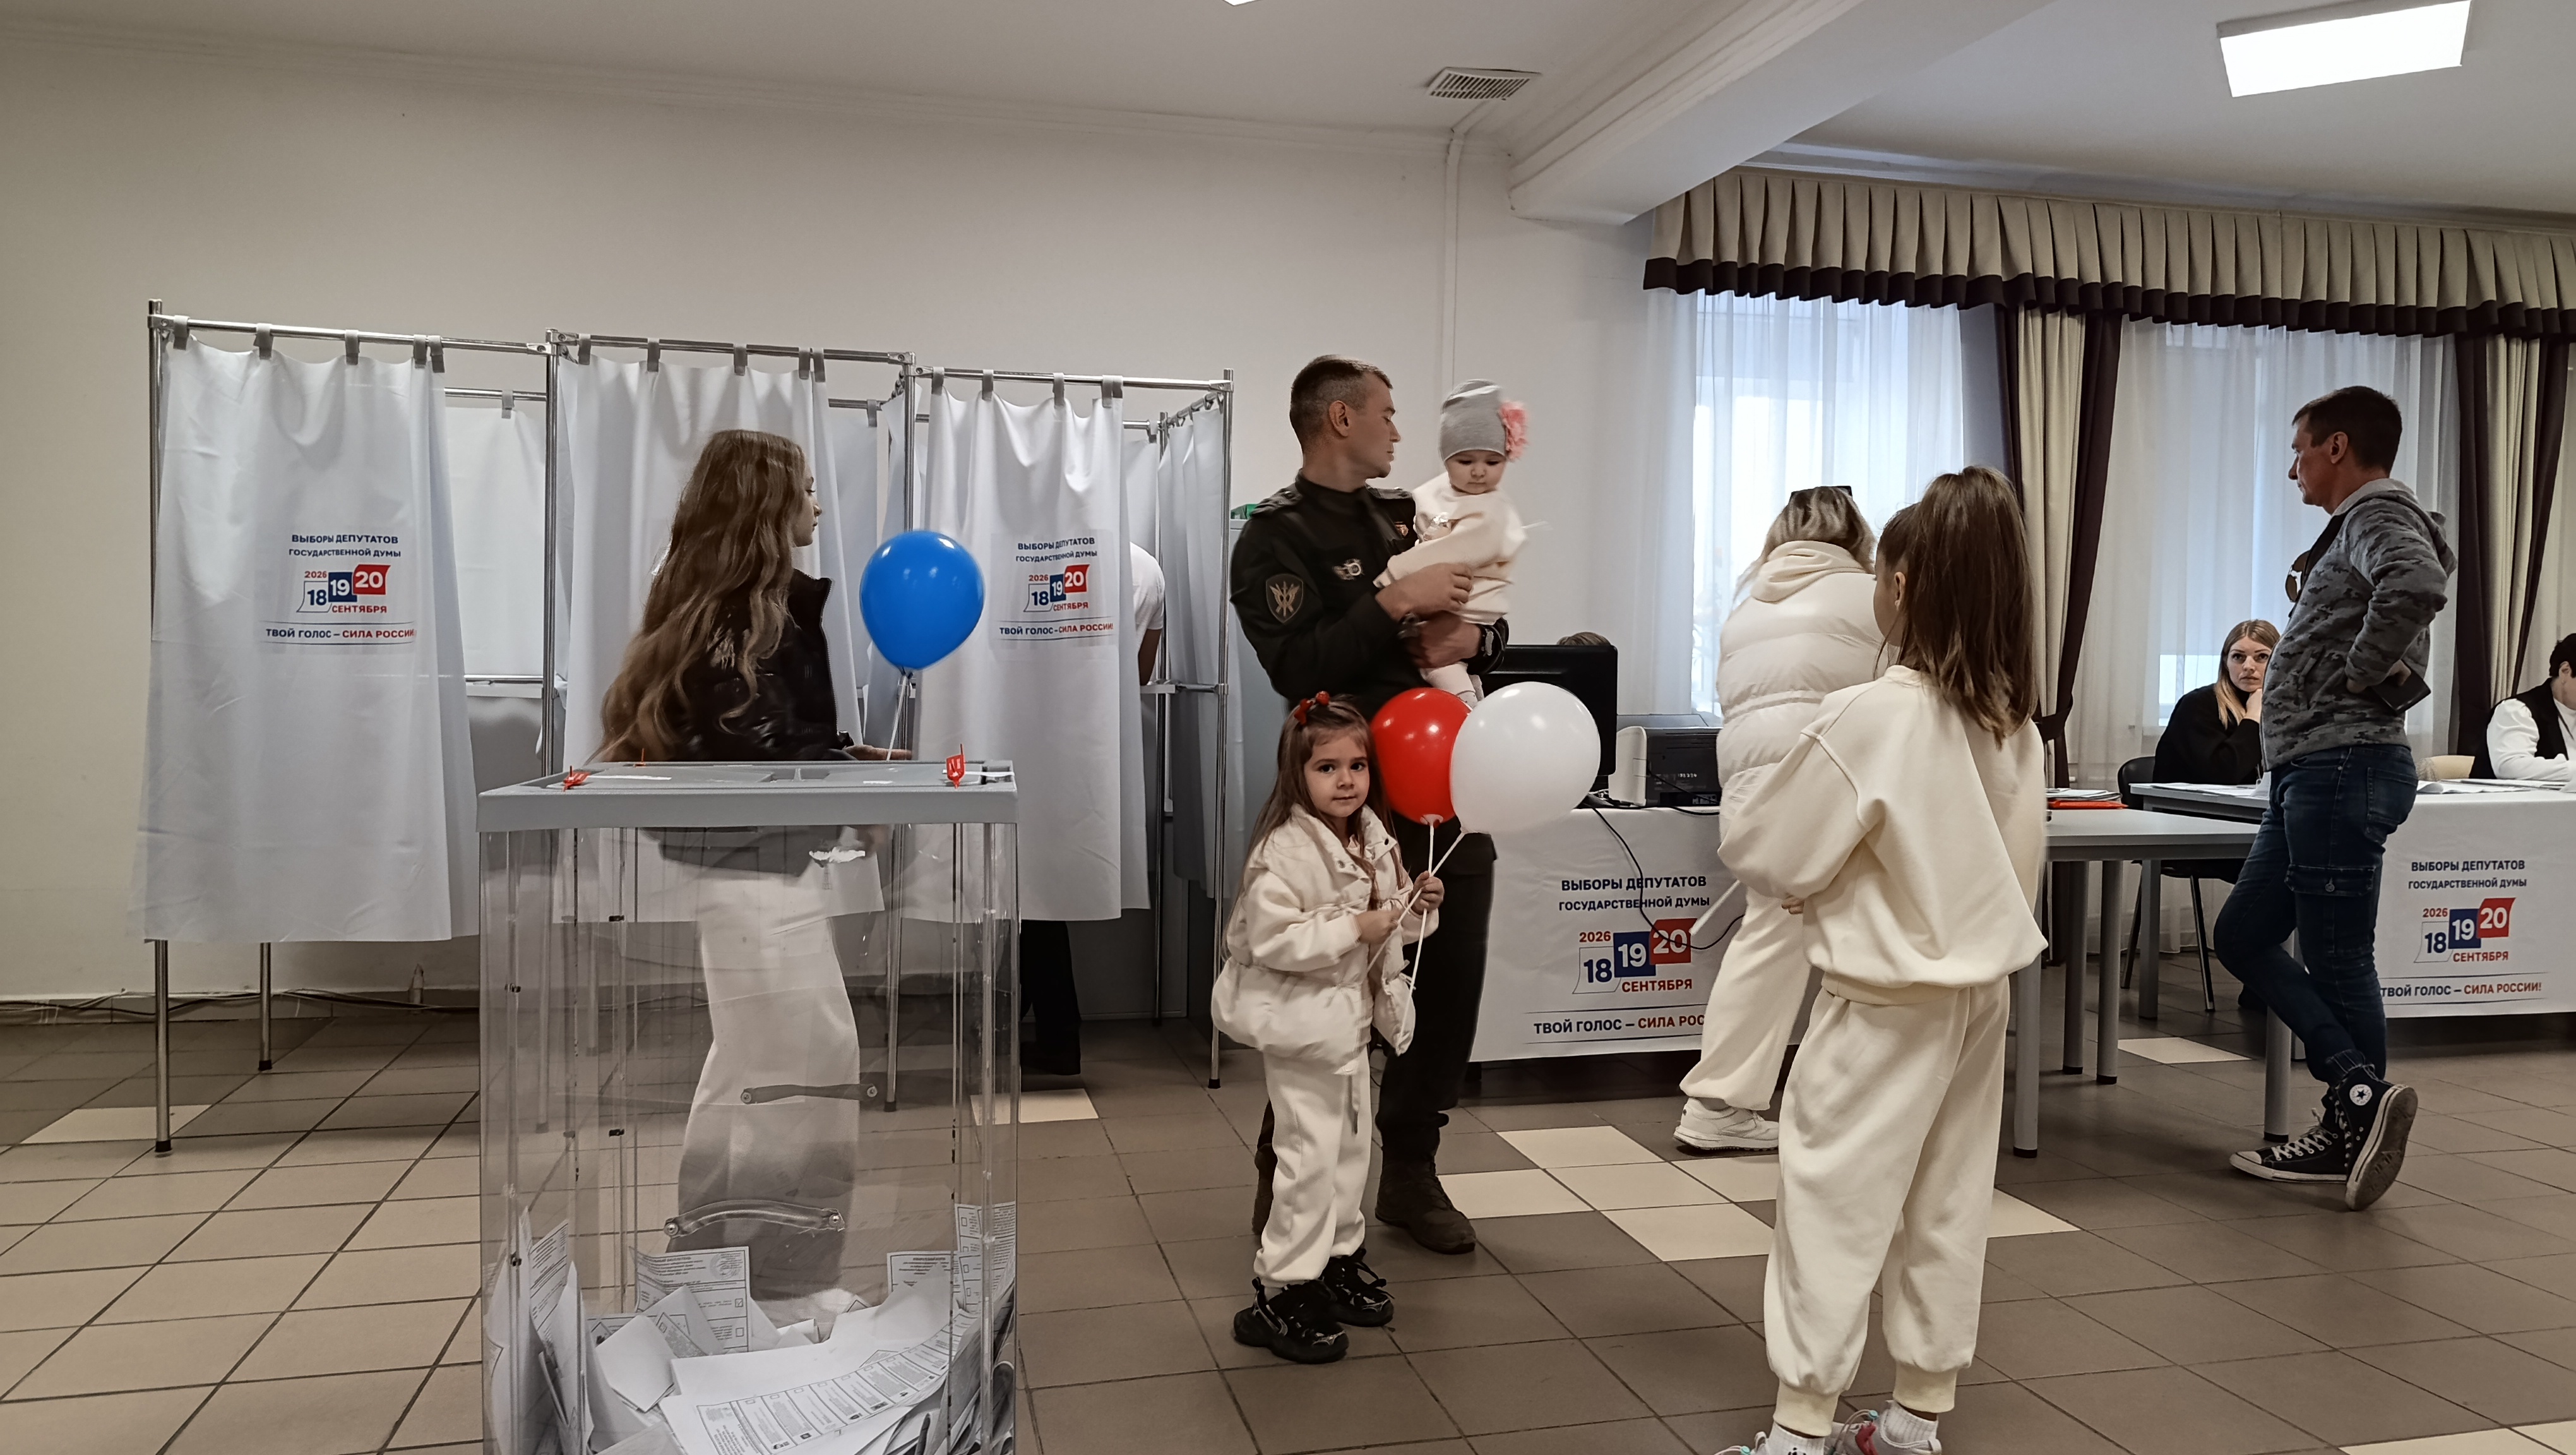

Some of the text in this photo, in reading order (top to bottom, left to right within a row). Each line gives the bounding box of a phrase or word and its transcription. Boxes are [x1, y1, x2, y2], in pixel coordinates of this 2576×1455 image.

[292, 535, 398, 544] ВЫБОРЫ ДЕПУТАТОВ
[1056, 537, 1095, 549] ДЕПУТАТОВ
[289, 548, 371, 557] ГОСУДАРСТВЕННОЙ
[1016, 551, 1073, 563] ГОСУДАРСТВЕННОЙ
[307, 572, 383, 606] 18 19 20
[1032, 572, 1084, 606] 18 19 20
[1054, 602, 1088, 611] СЕНТЯБРЯ
[266, 628, 295, 638] ТВОЙ
[999, 626, 1023, 635] ТВОЙ
[2411, 860, 2525, 872] ВЫБОРЫ ДЕПУТАТОВ
[1561, 877, 1707, 891] ВЫБОРЫ ДЕПУТАТОВ
[2408, 877, 2527, 889] ГОСУДАРСТВЕННОЙ ДУМЫ
[1559, 897, 1710, 911] ГОСУДАРСТВЕННОЙ ДУМЫ
[2423, 908, 2448, 918] 2026
[1579, 931, 1611, 942] 2026
[2424, 907, 2507, 954] 18 19 20
[1584, 930, 1687, 983] 18 19 20
[2452, 951, 2508, 962] СЕНТЯБРЯ
[1621, 979, 1692, 992] СЕНТЯБРЯ
[2380, 985, 2411, 997] ТВОЙ
[2414, 985, 2451, 996] ГОЛОС
[2464, 984, 2493, 995] СИЛА
[2496, 982, 2541, 993] РОССИИ!
[1534, 1019, 1572, 1034] ТВОЙ
[1577, 1020, 1621, 1032] ГОЛОС
[1638, 1017, 1675, 1029] СИЛА
